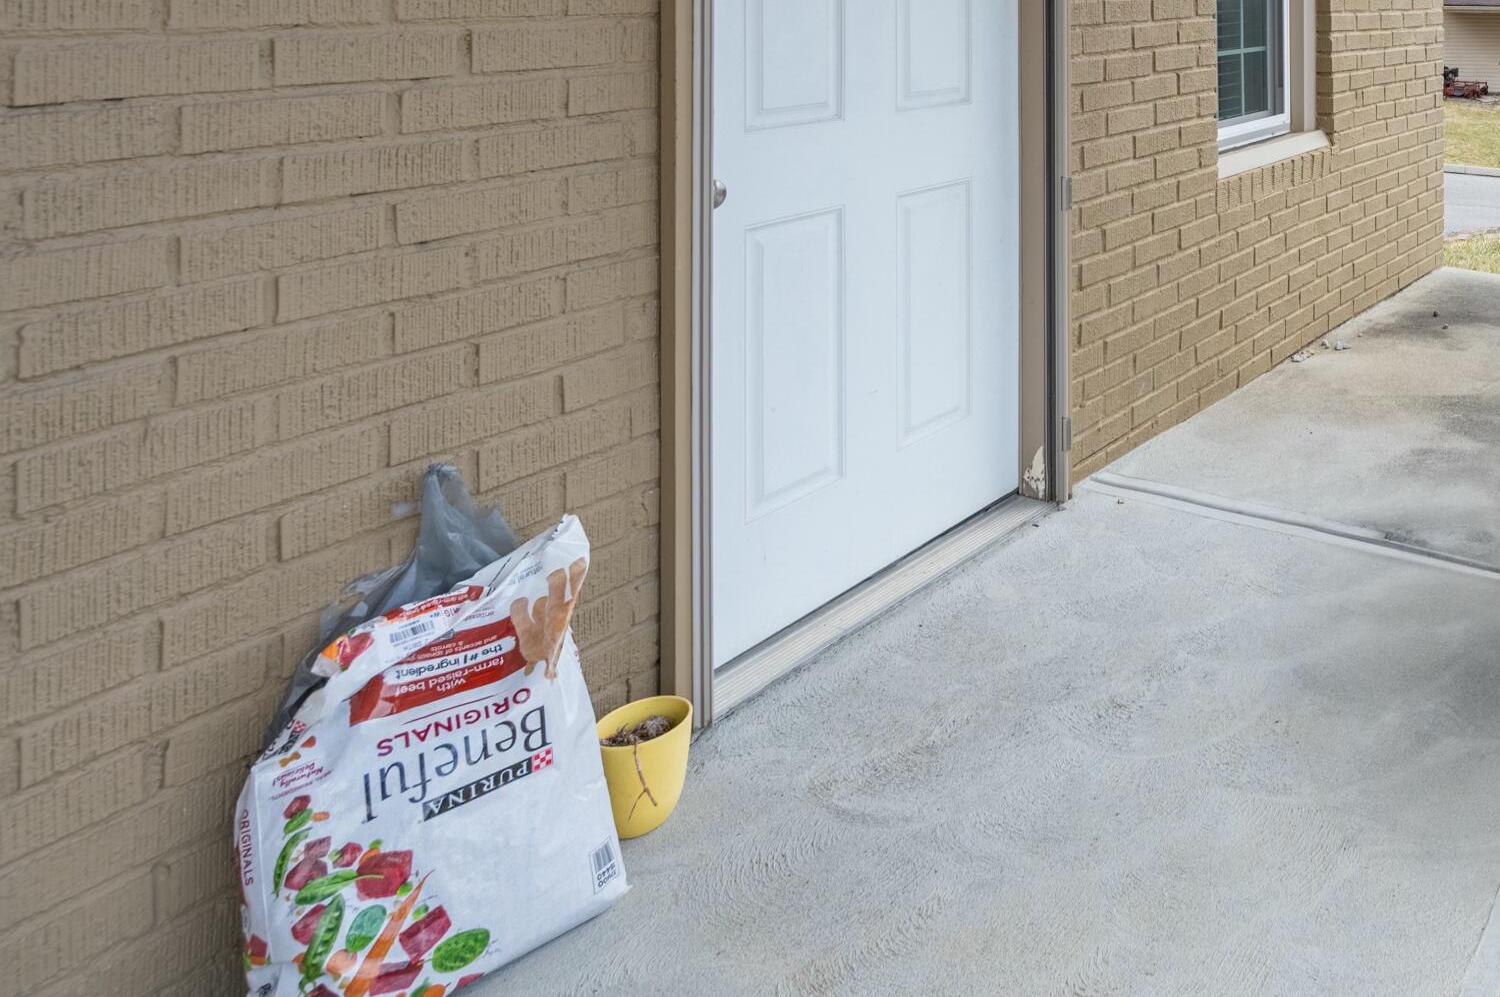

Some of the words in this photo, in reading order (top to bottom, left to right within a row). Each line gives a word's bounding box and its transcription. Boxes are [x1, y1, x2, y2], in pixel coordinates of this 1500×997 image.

[445, 647, 453, 655] of
[463, 652, 478, 663] #1
[481, 644, 502, 655] the
[395, 658, 459, 679] ingredient
[430, 656, 503, 684] farm-raised
[396, 683, 425, 696] beef
[437, 678, 465, 691] with
[376, 687, 531, 756] ORIGINALS
[363, 705, 552, 822] Beneful
[280, 766, 323, 786] Naturally
[425, 764, 530, 814] PURINA
[240, 809, 254, 886] ORIGINALS
